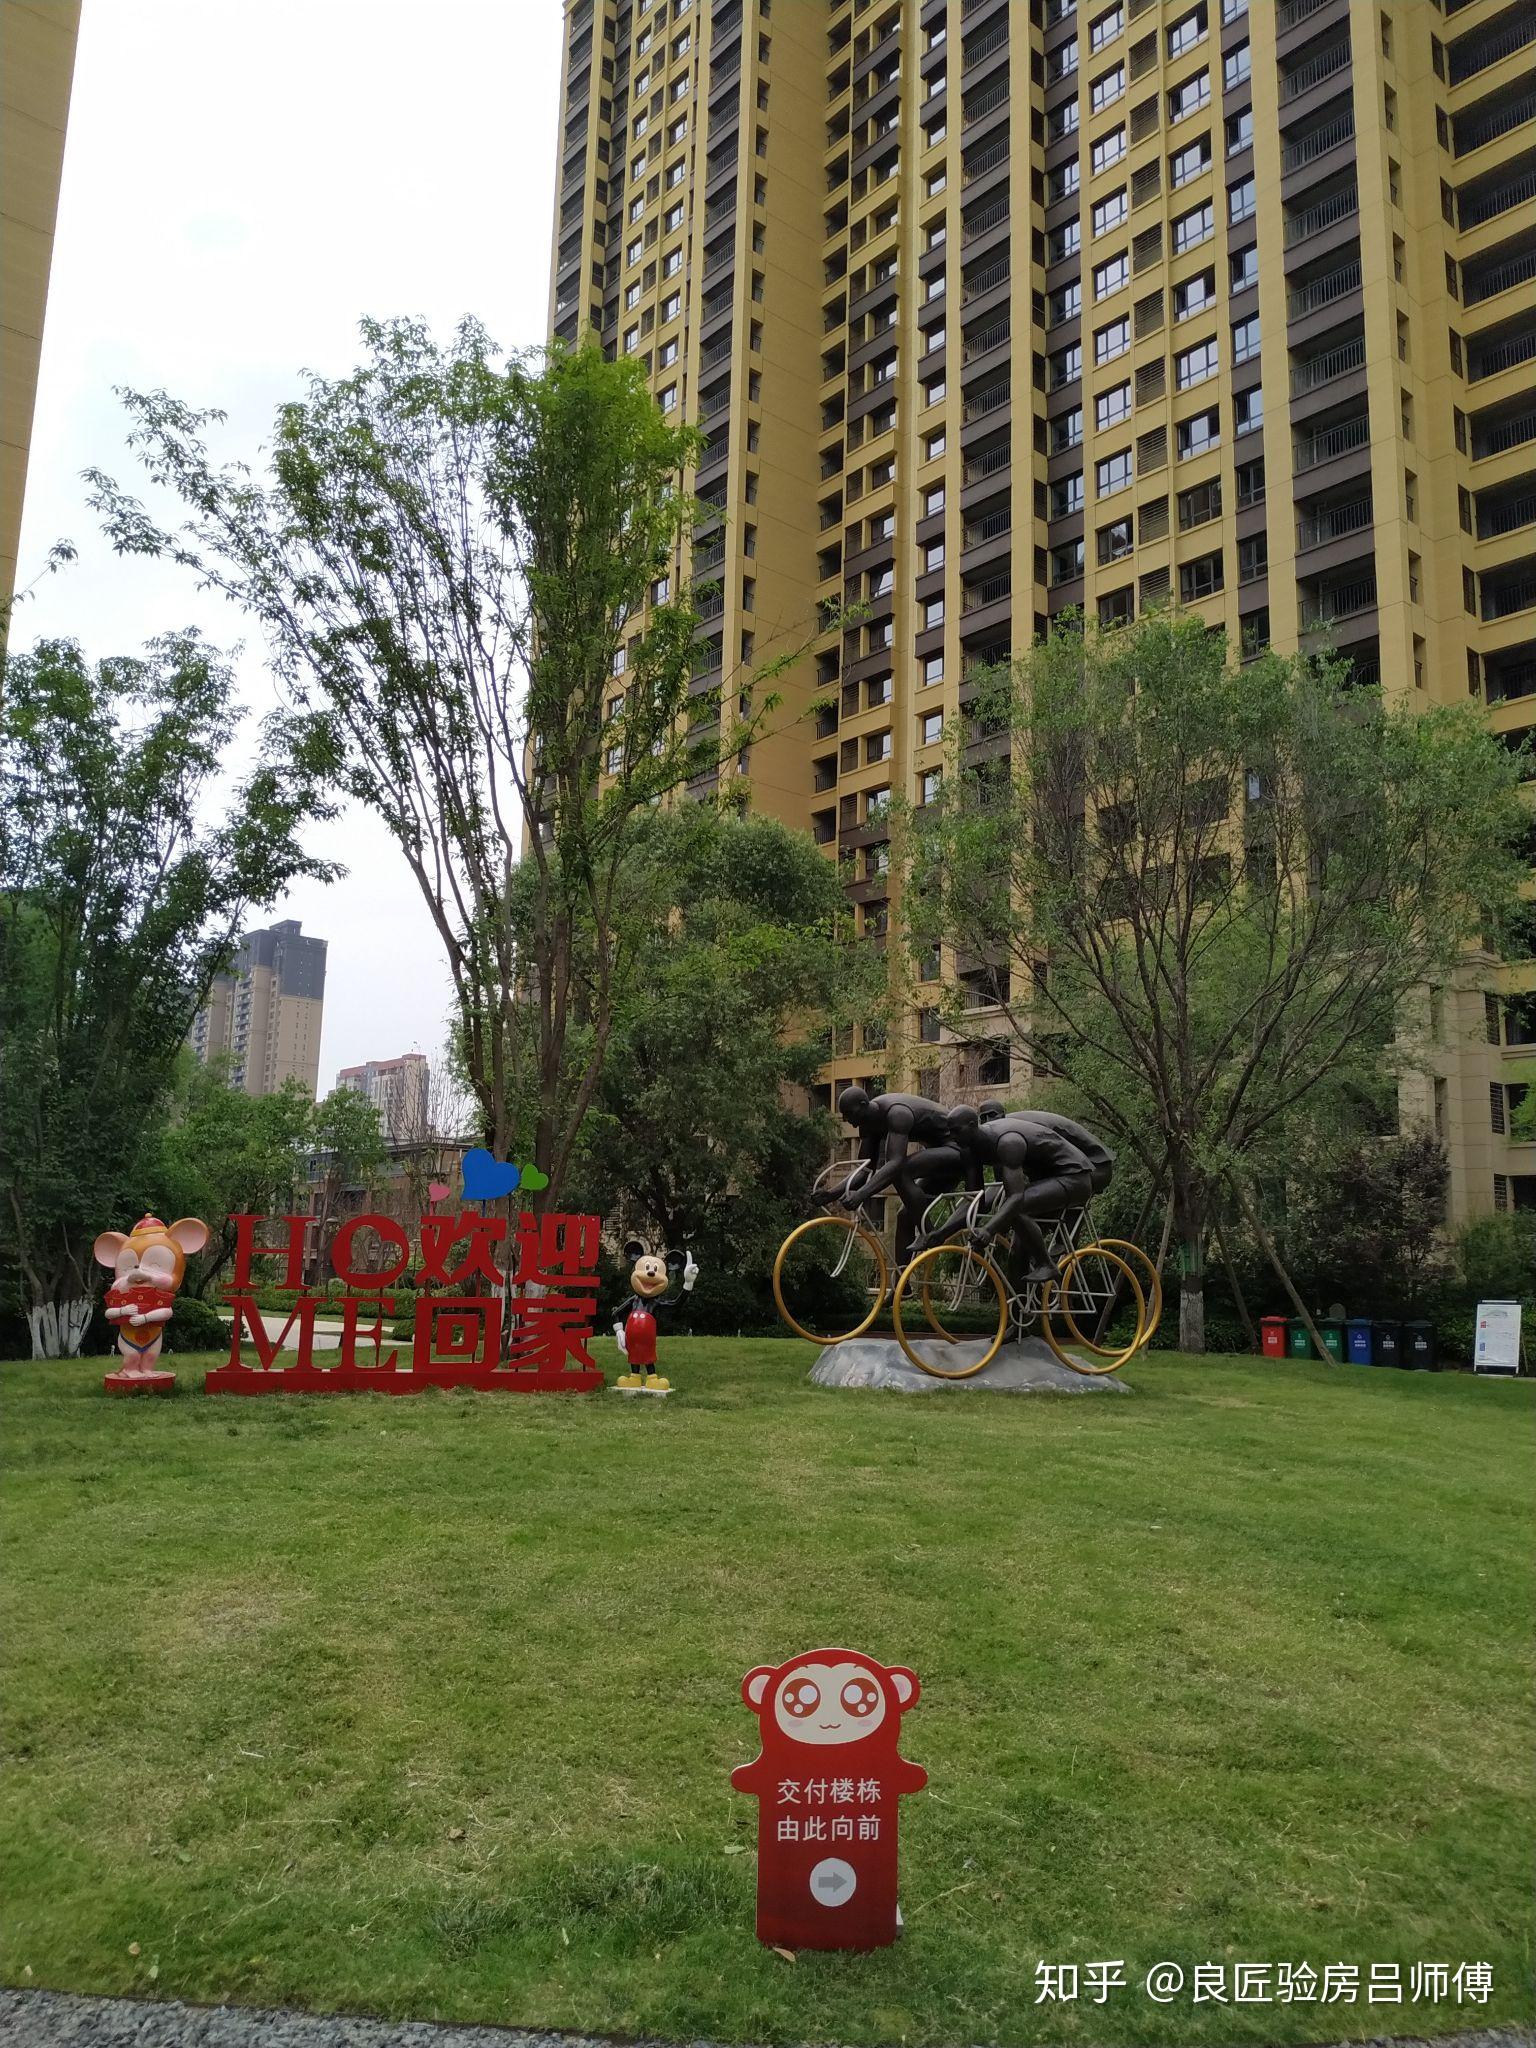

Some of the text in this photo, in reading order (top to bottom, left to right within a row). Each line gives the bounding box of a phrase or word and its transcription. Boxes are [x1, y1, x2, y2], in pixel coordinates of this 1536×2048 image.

[417, 1210, 601, 1287] 欢迎
[412, 1294, 597, 1372] 回家
[776, 1777, 882, 1805] 交付楼栋
[776, 1814, 882, 1842] 由此向前
